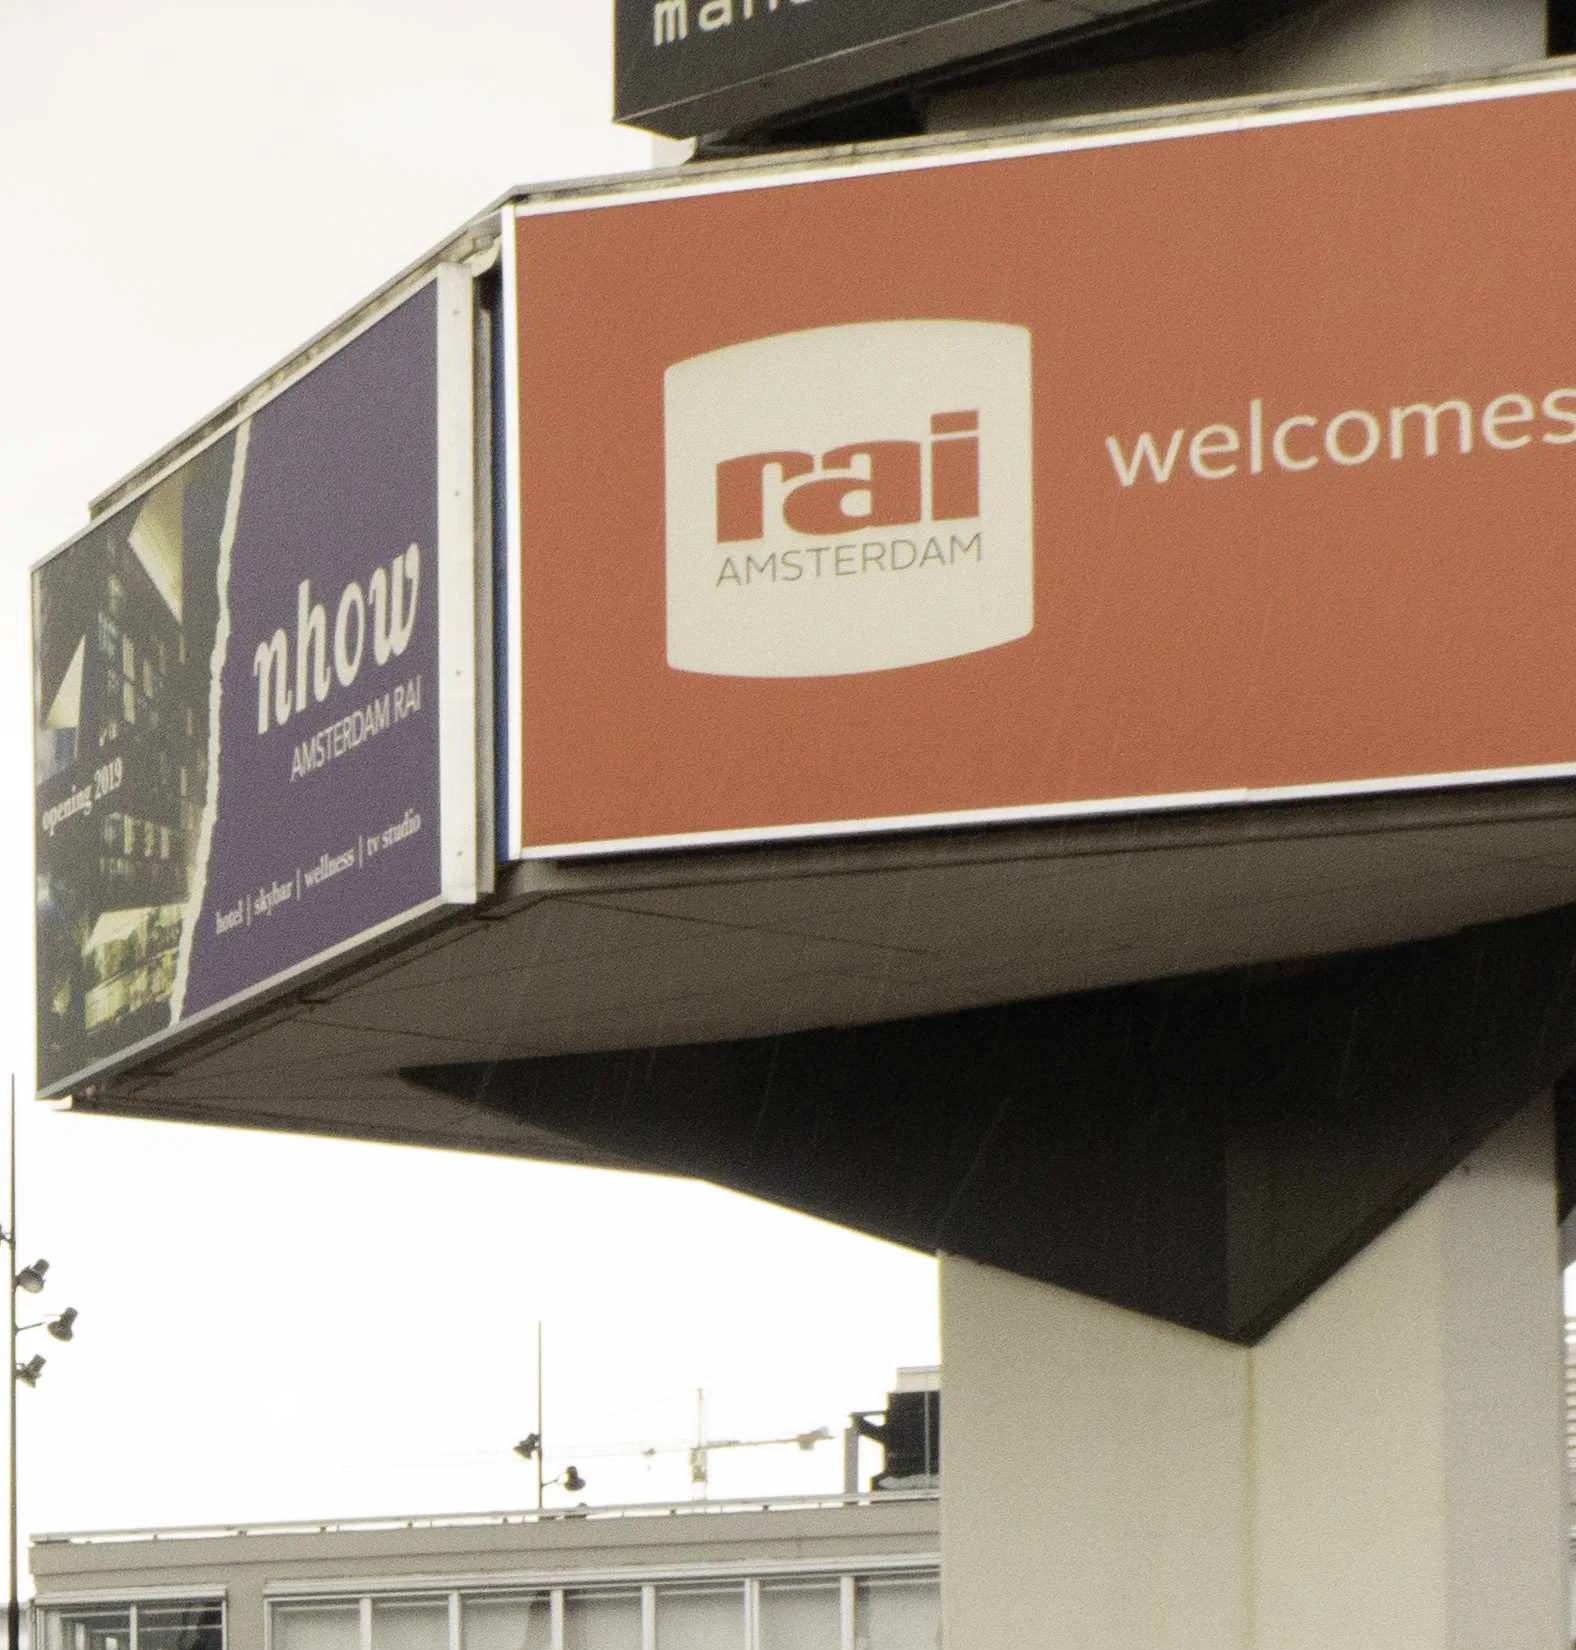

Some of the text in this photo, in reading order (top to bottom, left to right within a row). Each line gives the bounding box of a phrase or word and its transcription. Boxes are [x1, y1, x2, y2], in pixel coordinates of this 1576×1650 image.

[715, 408, 981, 545] rai
[1105, 387, 1576, 488] welcomes
[715, 531, 983, 589] AMSTERDAM
[252, 541, 421, 735] nhow
[289, 675, 423, 783] AMSTERDAM RAI
[41, 756, 124, 837] opening 2019
[214, 807, 422, 936] hotel skybar wellness tv studio
